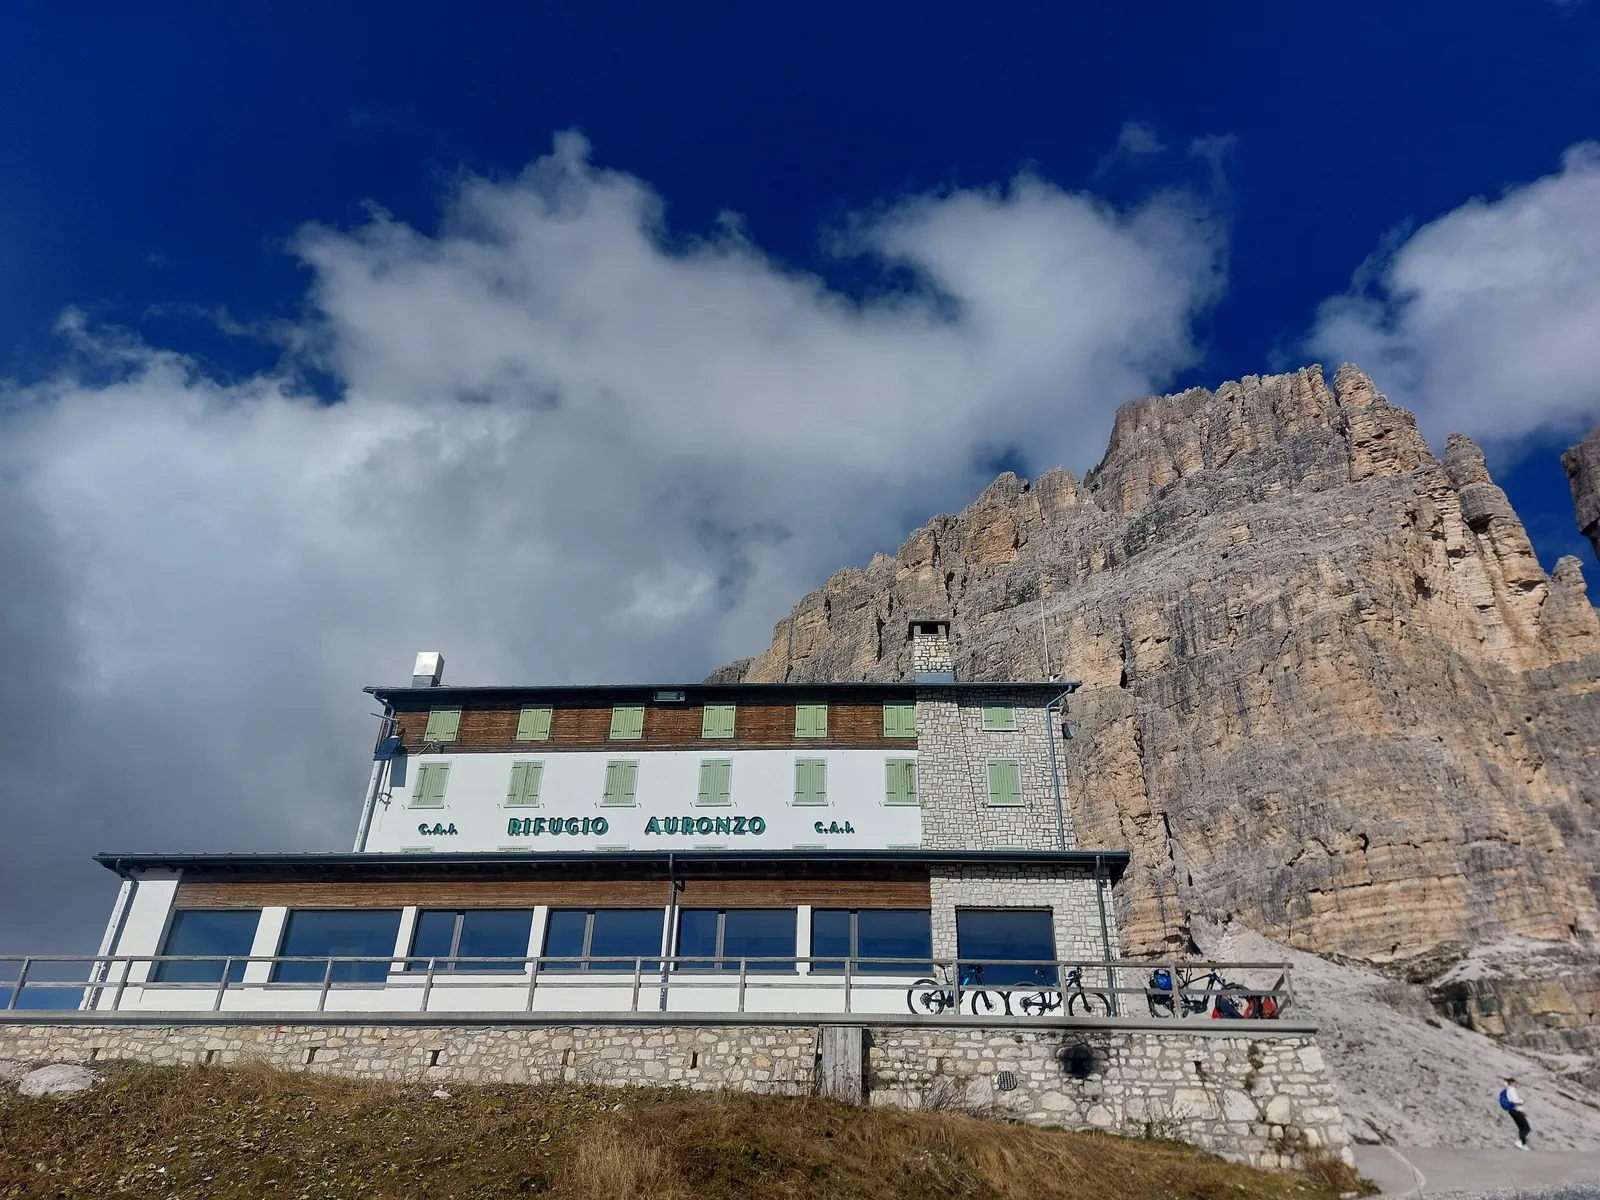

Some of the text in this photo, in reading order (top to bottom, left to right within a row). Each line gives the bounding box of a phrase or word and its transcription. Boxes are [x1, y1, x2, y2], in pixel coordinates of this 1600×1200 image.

[507, 817, 609, 836] RIFUGIO
[644, 816, 766, 836] AURONZO
[814, 821, 855, 834] C.A.I.
